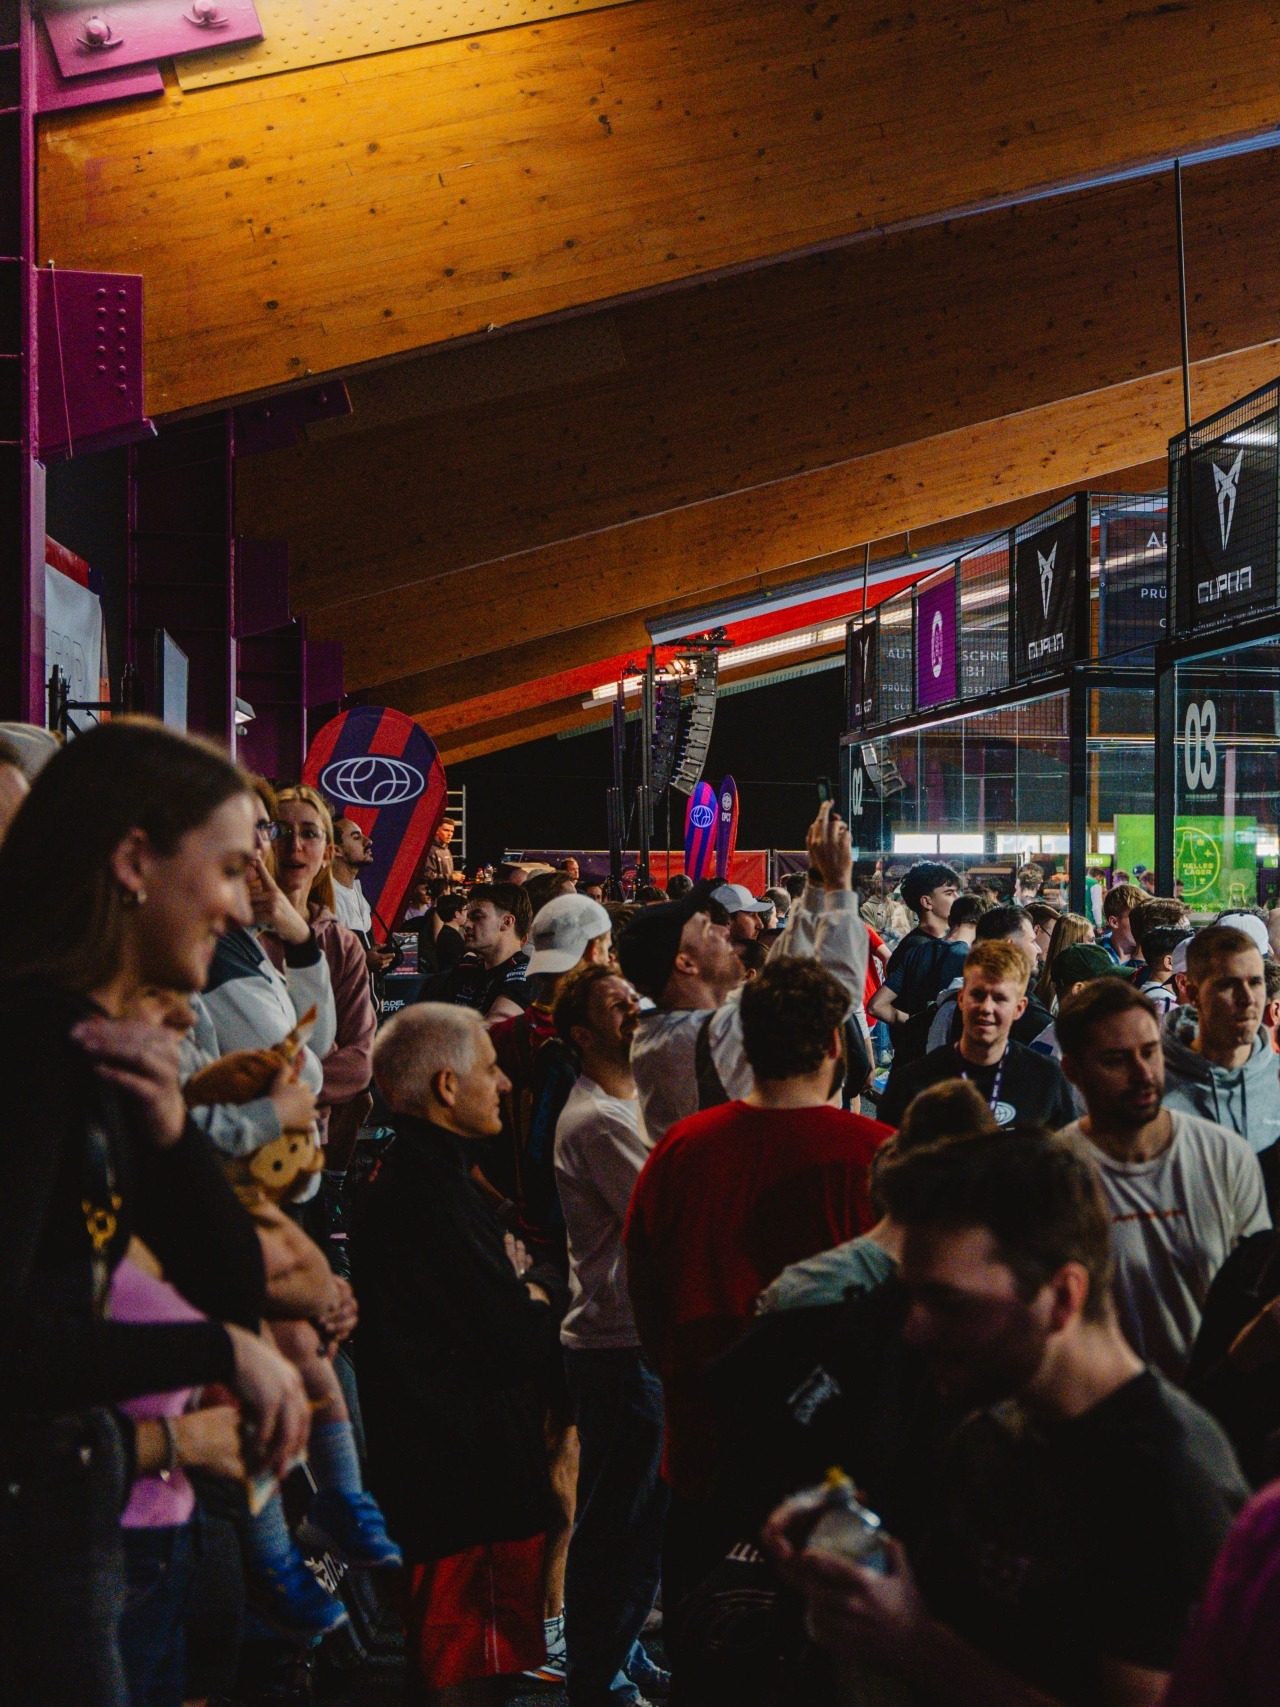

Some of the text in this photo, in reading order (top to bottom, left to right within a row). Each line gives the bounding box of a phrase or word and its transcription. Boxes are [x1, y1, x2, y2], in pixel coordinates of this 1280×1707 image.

[1197, 566, 1252, 604] CUPRA
[1028, 632, 1064, 660] CUPRA
[1184, 699, 1217, 790] 03
[852, 767, 863, 816] 02
